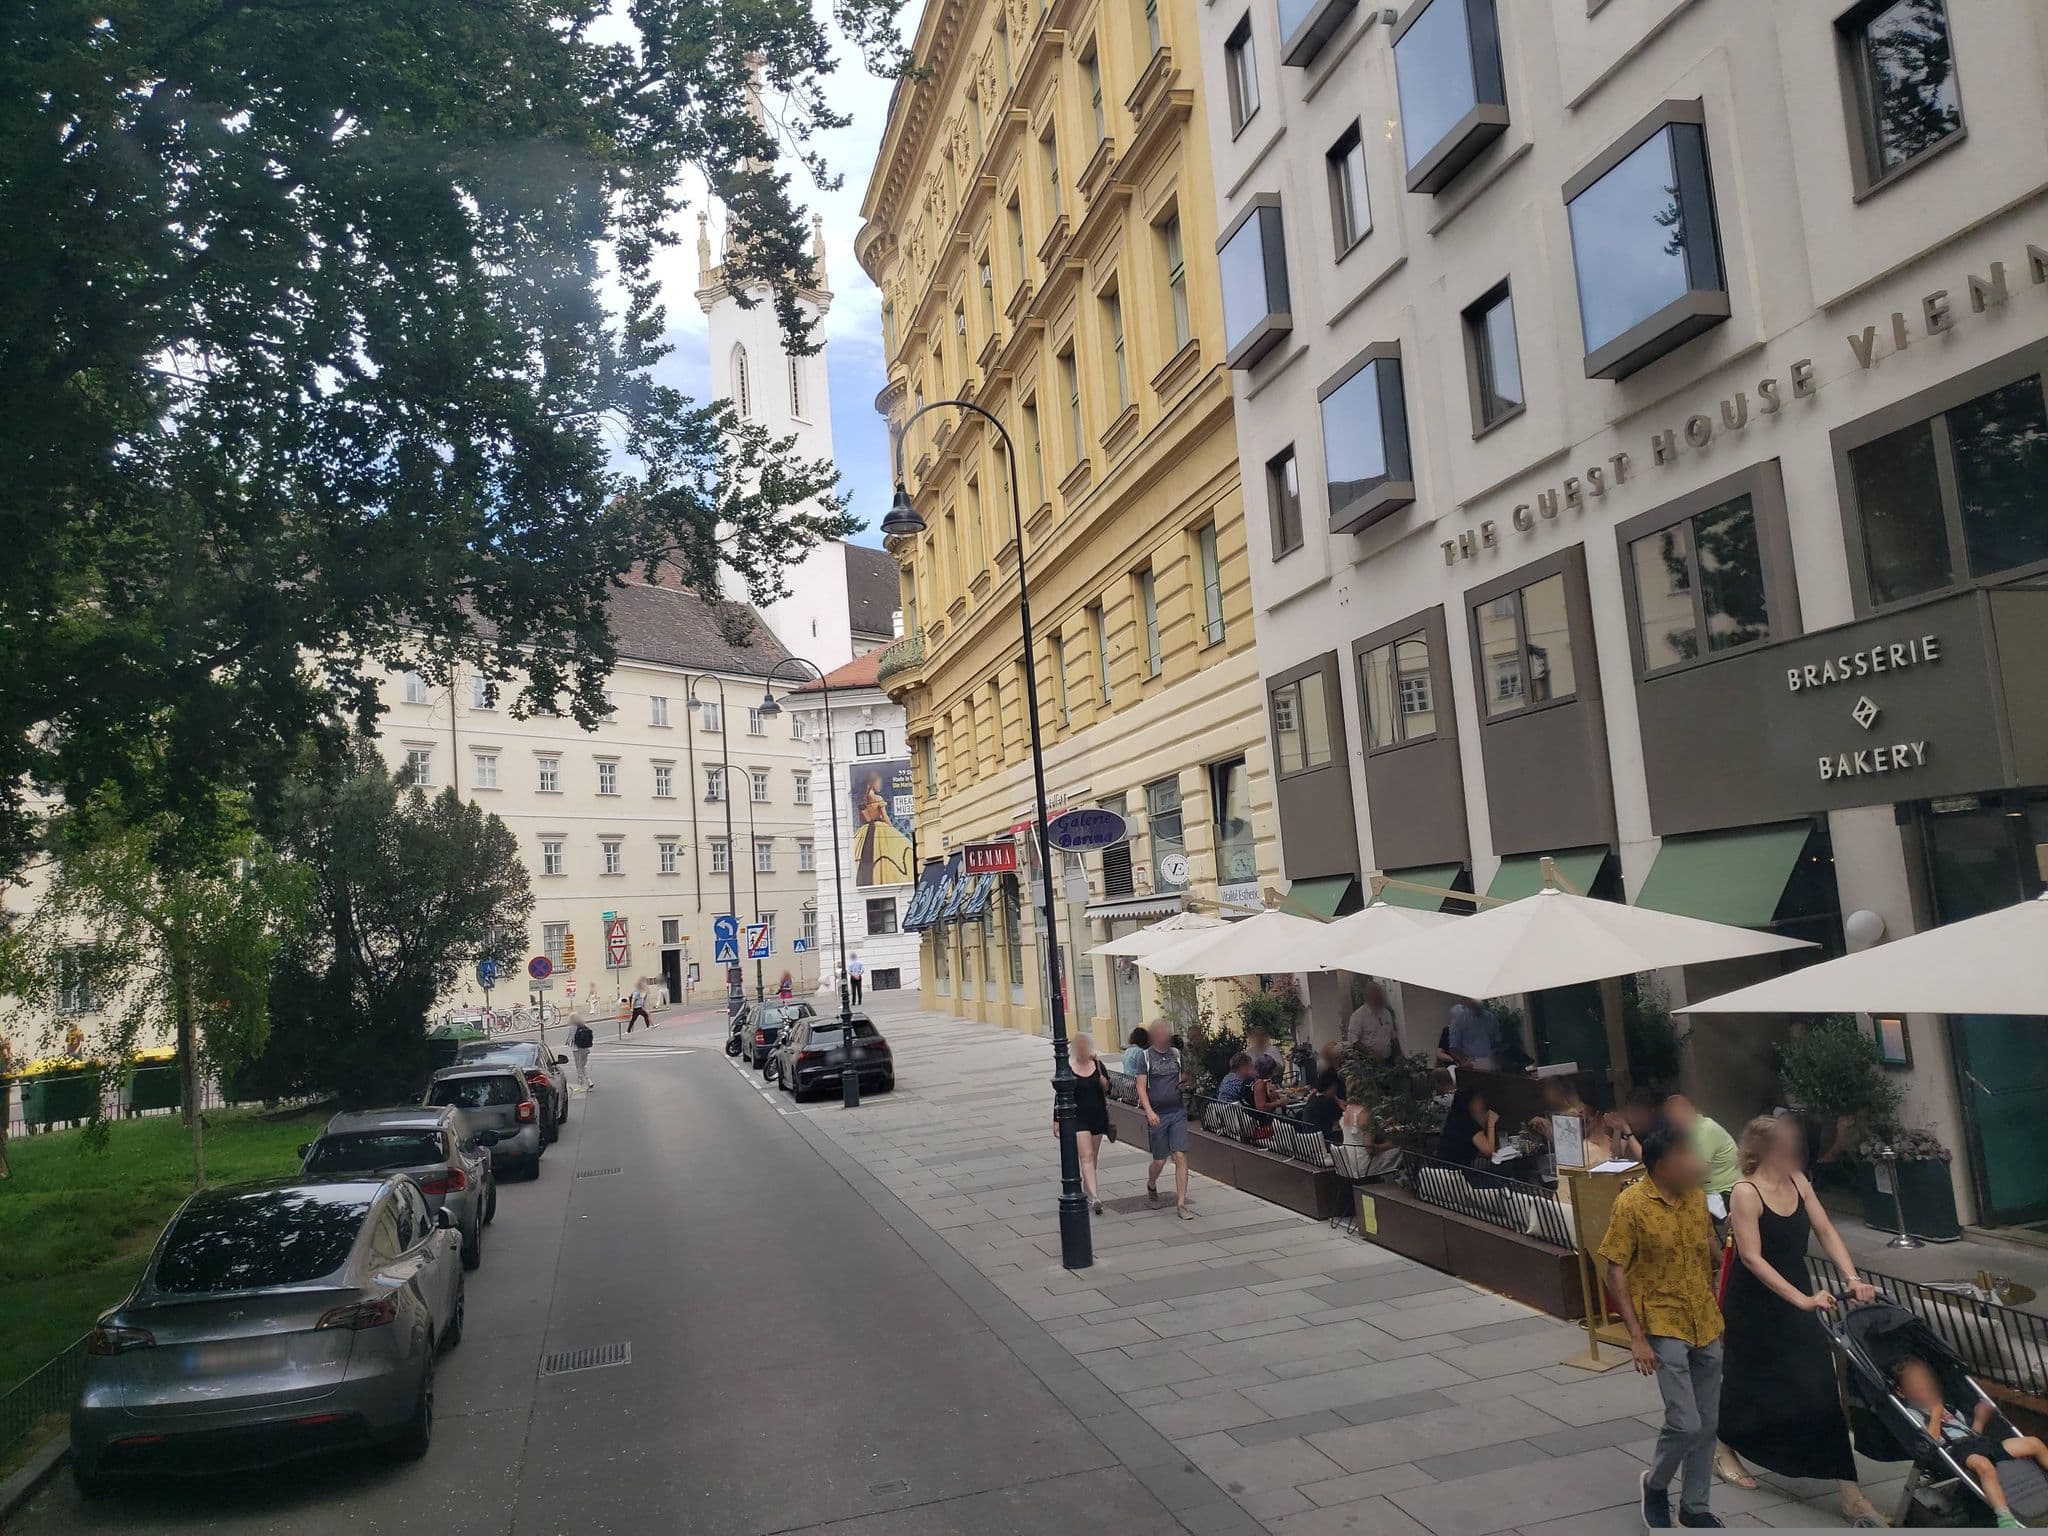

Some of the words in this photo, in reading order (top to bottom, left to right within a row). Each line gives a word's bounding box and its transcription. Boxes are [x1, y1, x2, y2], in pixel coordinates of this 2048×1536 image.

[1440, 519, 1498, 566] THE
[1512, 452, 1631, 532] GUEST
[1650, 358, 1819, 466] HOUSE
[1787, 634, 1941, 691] BRASSERIE
[1818, 740, 1928, 780] BAKERY
[1057, 812, 1111, 833] Galerie
[969, 849, 1011, 867] GEMMA
